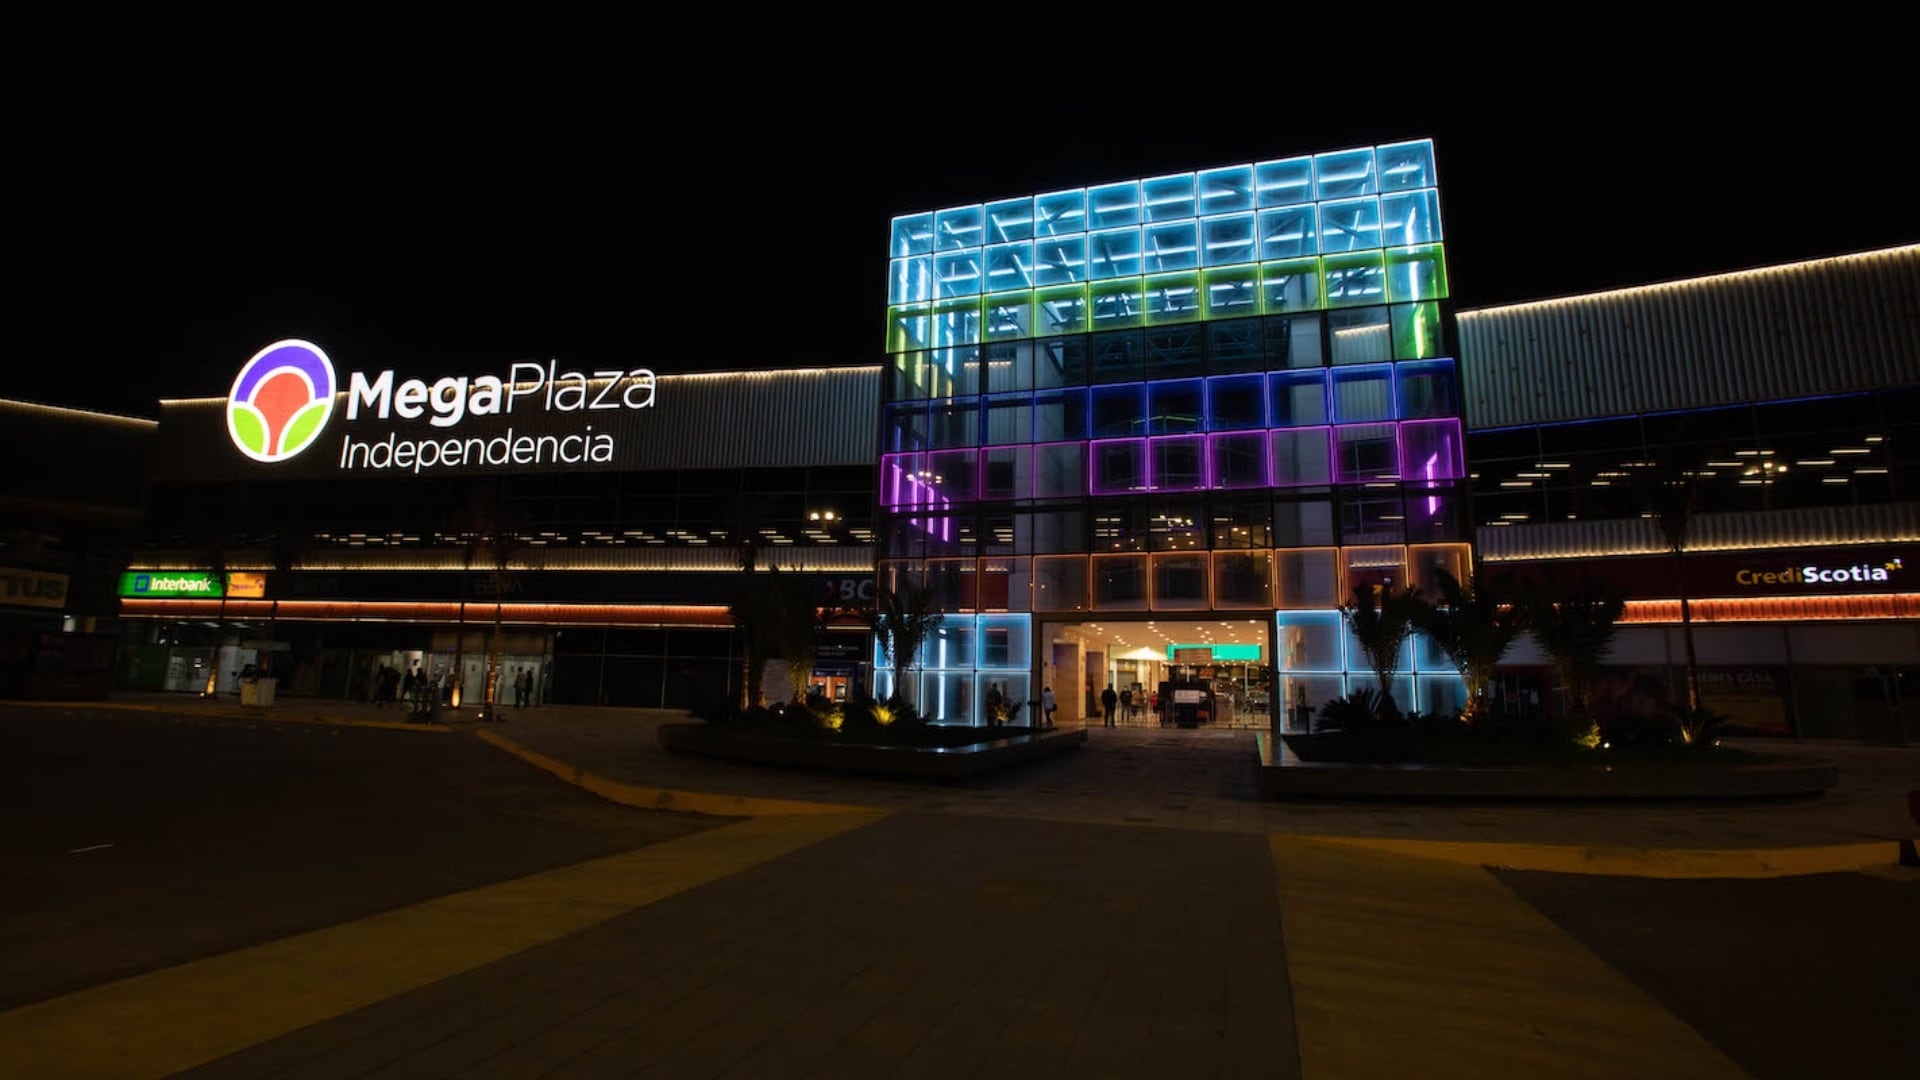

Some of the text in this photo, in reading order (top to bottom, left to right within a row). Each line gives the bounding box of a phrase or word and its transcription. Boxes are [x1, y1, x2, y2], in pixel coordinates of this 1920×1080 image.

[346, 359, 657, 427] MegaPlaza
[340, 425, 614, 474] Independencia
[151, 577, 212, 591] Interbank
[1735, 563, 1888, 586] CrediScotia
